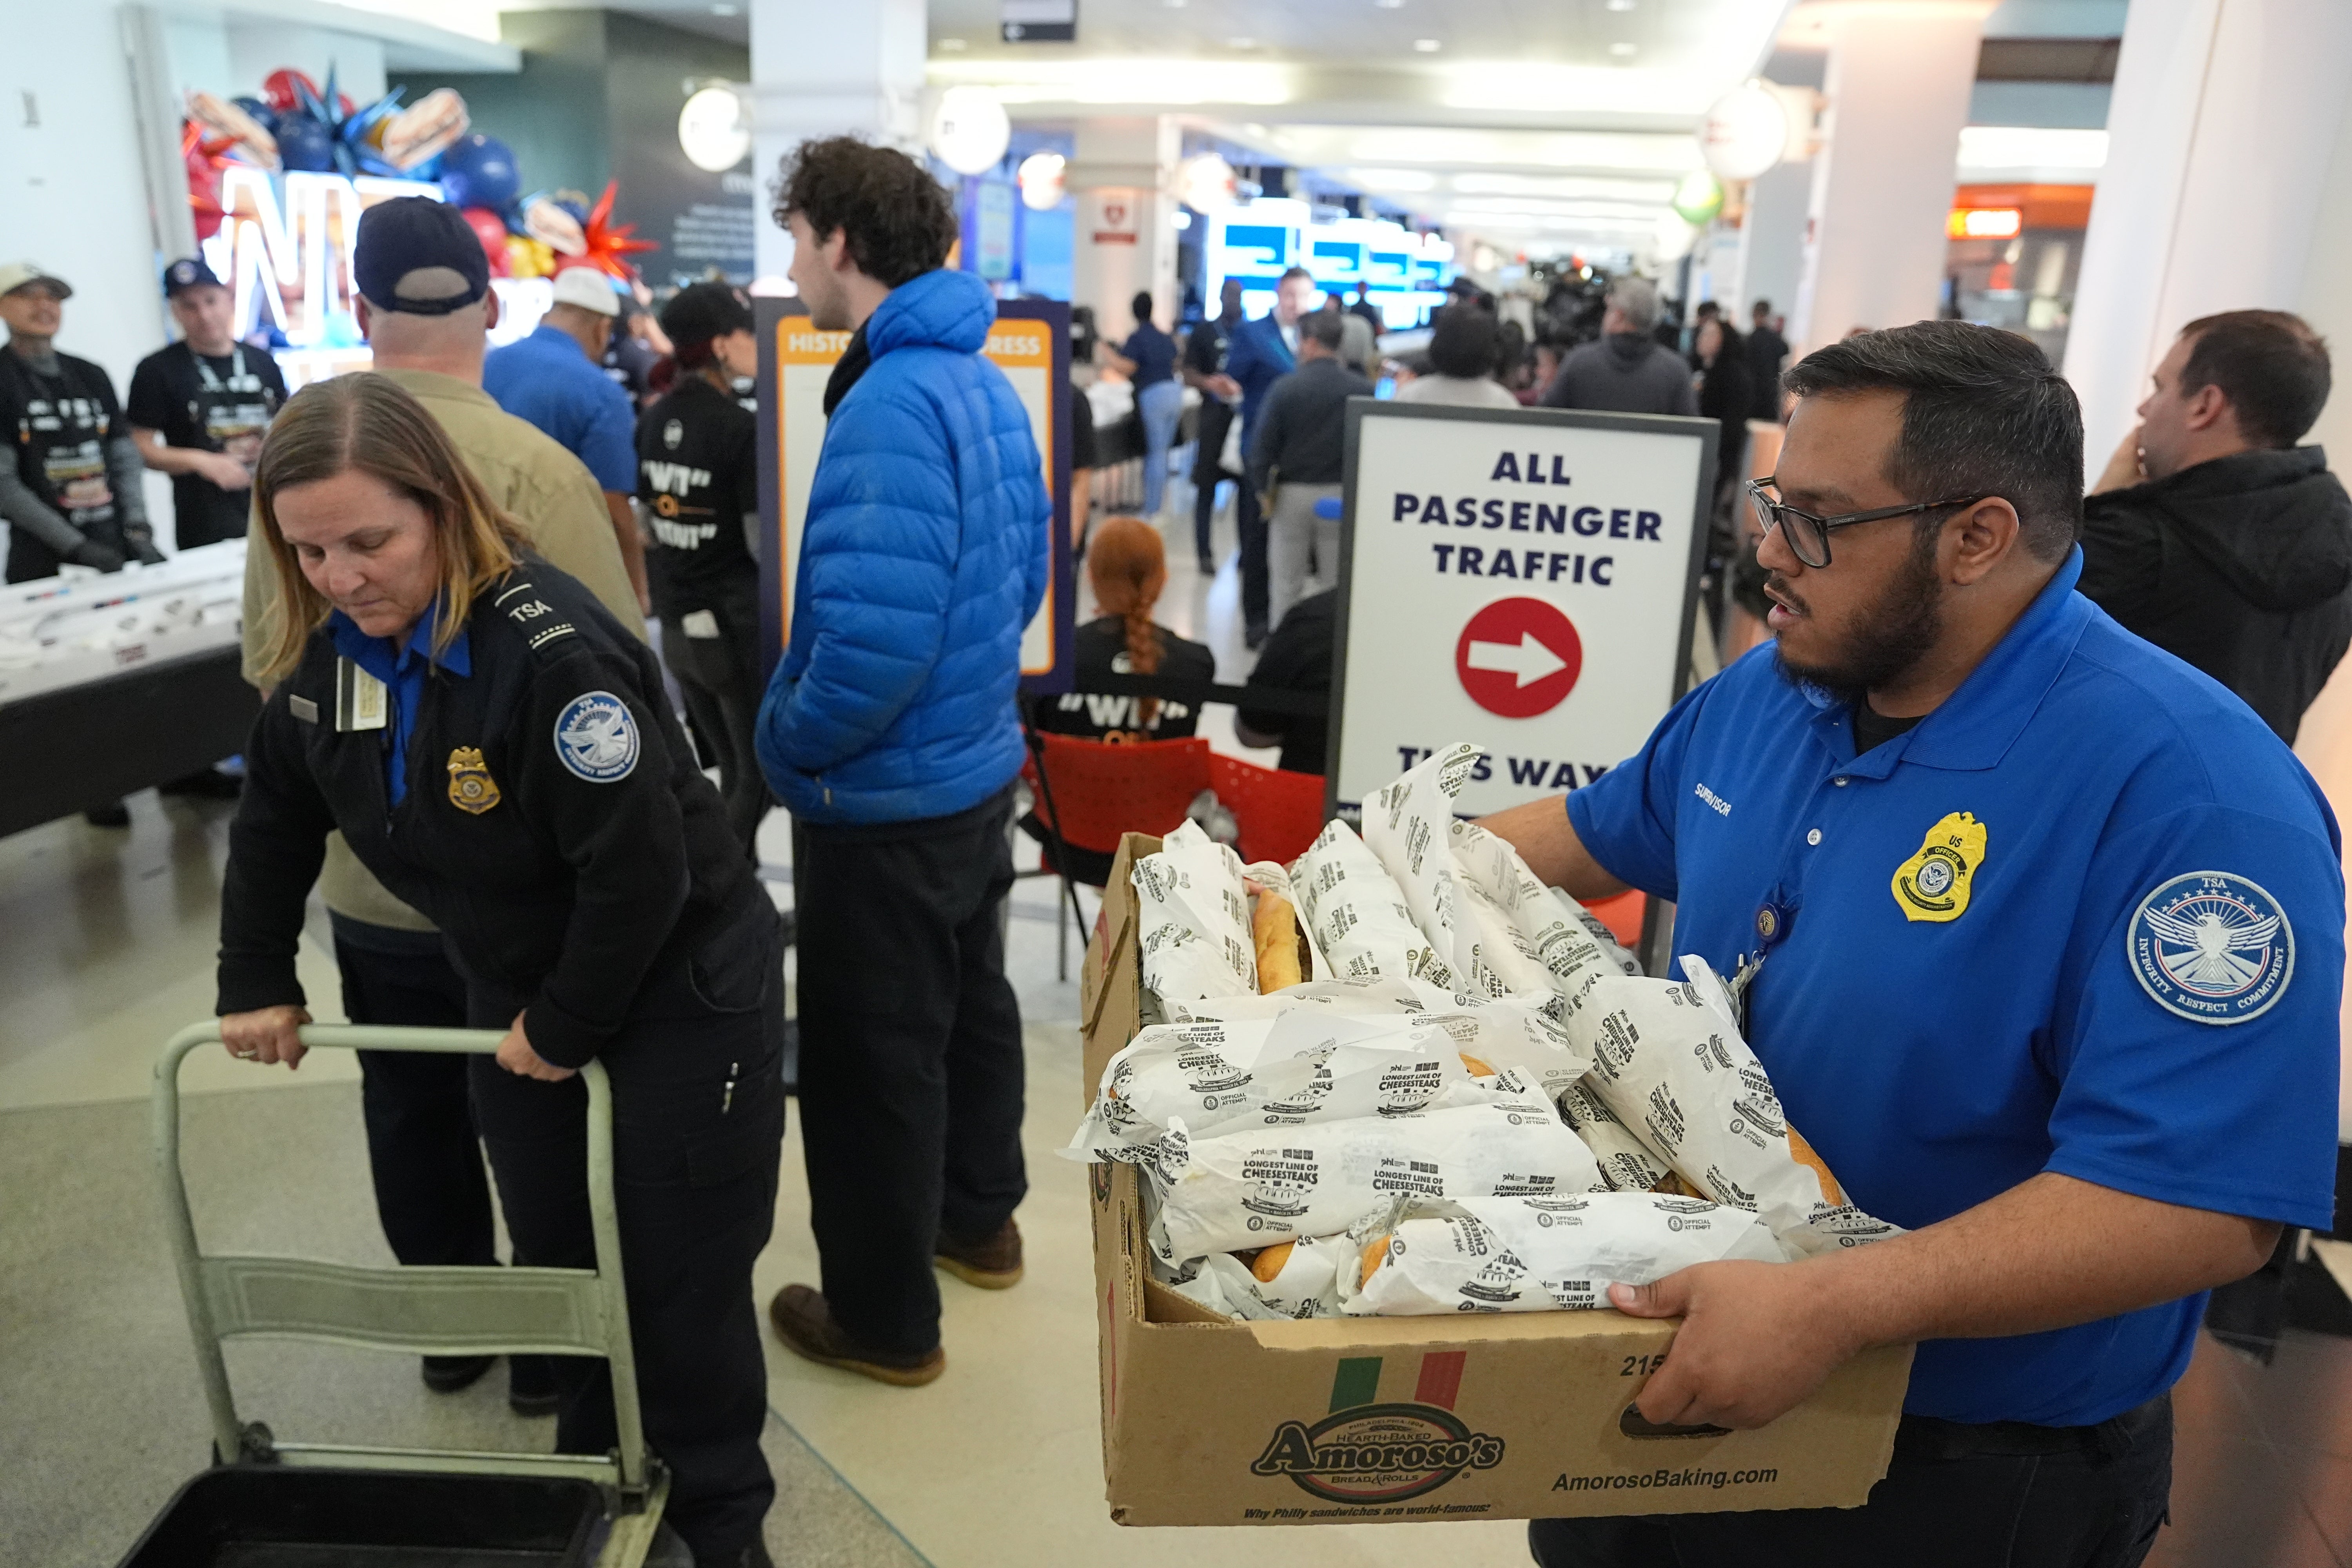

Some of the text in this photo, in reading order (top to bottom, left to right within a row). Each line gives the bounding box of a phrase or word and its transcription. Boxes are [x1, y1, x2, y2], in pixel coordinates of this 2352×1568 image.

[788, 332, 1042, 356] HISTO RESS
[1490, 451, 1571, 486] ALL
[1393, 493, 1662, 542] PASSENGER
[1433, 544, 1614, 586] TRAFFIC
[508, 599, 552, 623] TSA
[1398, 746, 1608, 789] TS WAY
[1695, 783, 1731, 817] SUPERVISOR
[1949, 835, 1962, 847] US
[1935, 847, 1960, 864] OFFICER
[2202, 877, 2227, 889] TSA
[2139, 937, 2283, 1012] INTEGRITY RESPECT COMMITMENT
[1609, 1012, 1624, 1035] LONGEST
[1622, 1034, 1631, 1047] LINE
[1602, 1018, 1632, 1063] CHEESESTEAKS
[1178, 1059, 1224, 1069] CHEESEST
[1704, 1053, 1715, 1071] OFFICIAL
[1379, 1079, 1440, 1091] CHEESESTEAKS
[1650, 1091, 1683, 1142] CHEESESTEAKS
[1656, 1085, 1685, 1132] LONGEST LINE OF
[1744, 1133, 1766, 1151] ATTEMPT
[1746, 1129, 1767, 1146] OFFICIAL
[1244, 1160, 1284, 1169] LONGEST
[1286, 1162, 1305, 1171] LINE
[1381, 1158, 1394, 1167] phl
[1242, 1168, 1318, 1184] CHEESESTEAKS
[1374, 1170, 1412, 1180] LONGEST
[1372, 1178, 1444, 1196] CHEESESTEAKS
[1336, 1432, 1431, 1443] HEARTH-BAKED
[1254, 1421, 1504, 1474] Amoroso's
[1383, 1474, 1419, 1482] ROLLS
[1552, 1468, 1778, 1491] AmorosoBaking.com
[1244, 1508, 1269, 1519] Why
[1272, 1506, 1308, 1520] Philly
[1310, 1506, 1380, 1517] sandwiches
[1383, 1506, 1404, 1516] are
